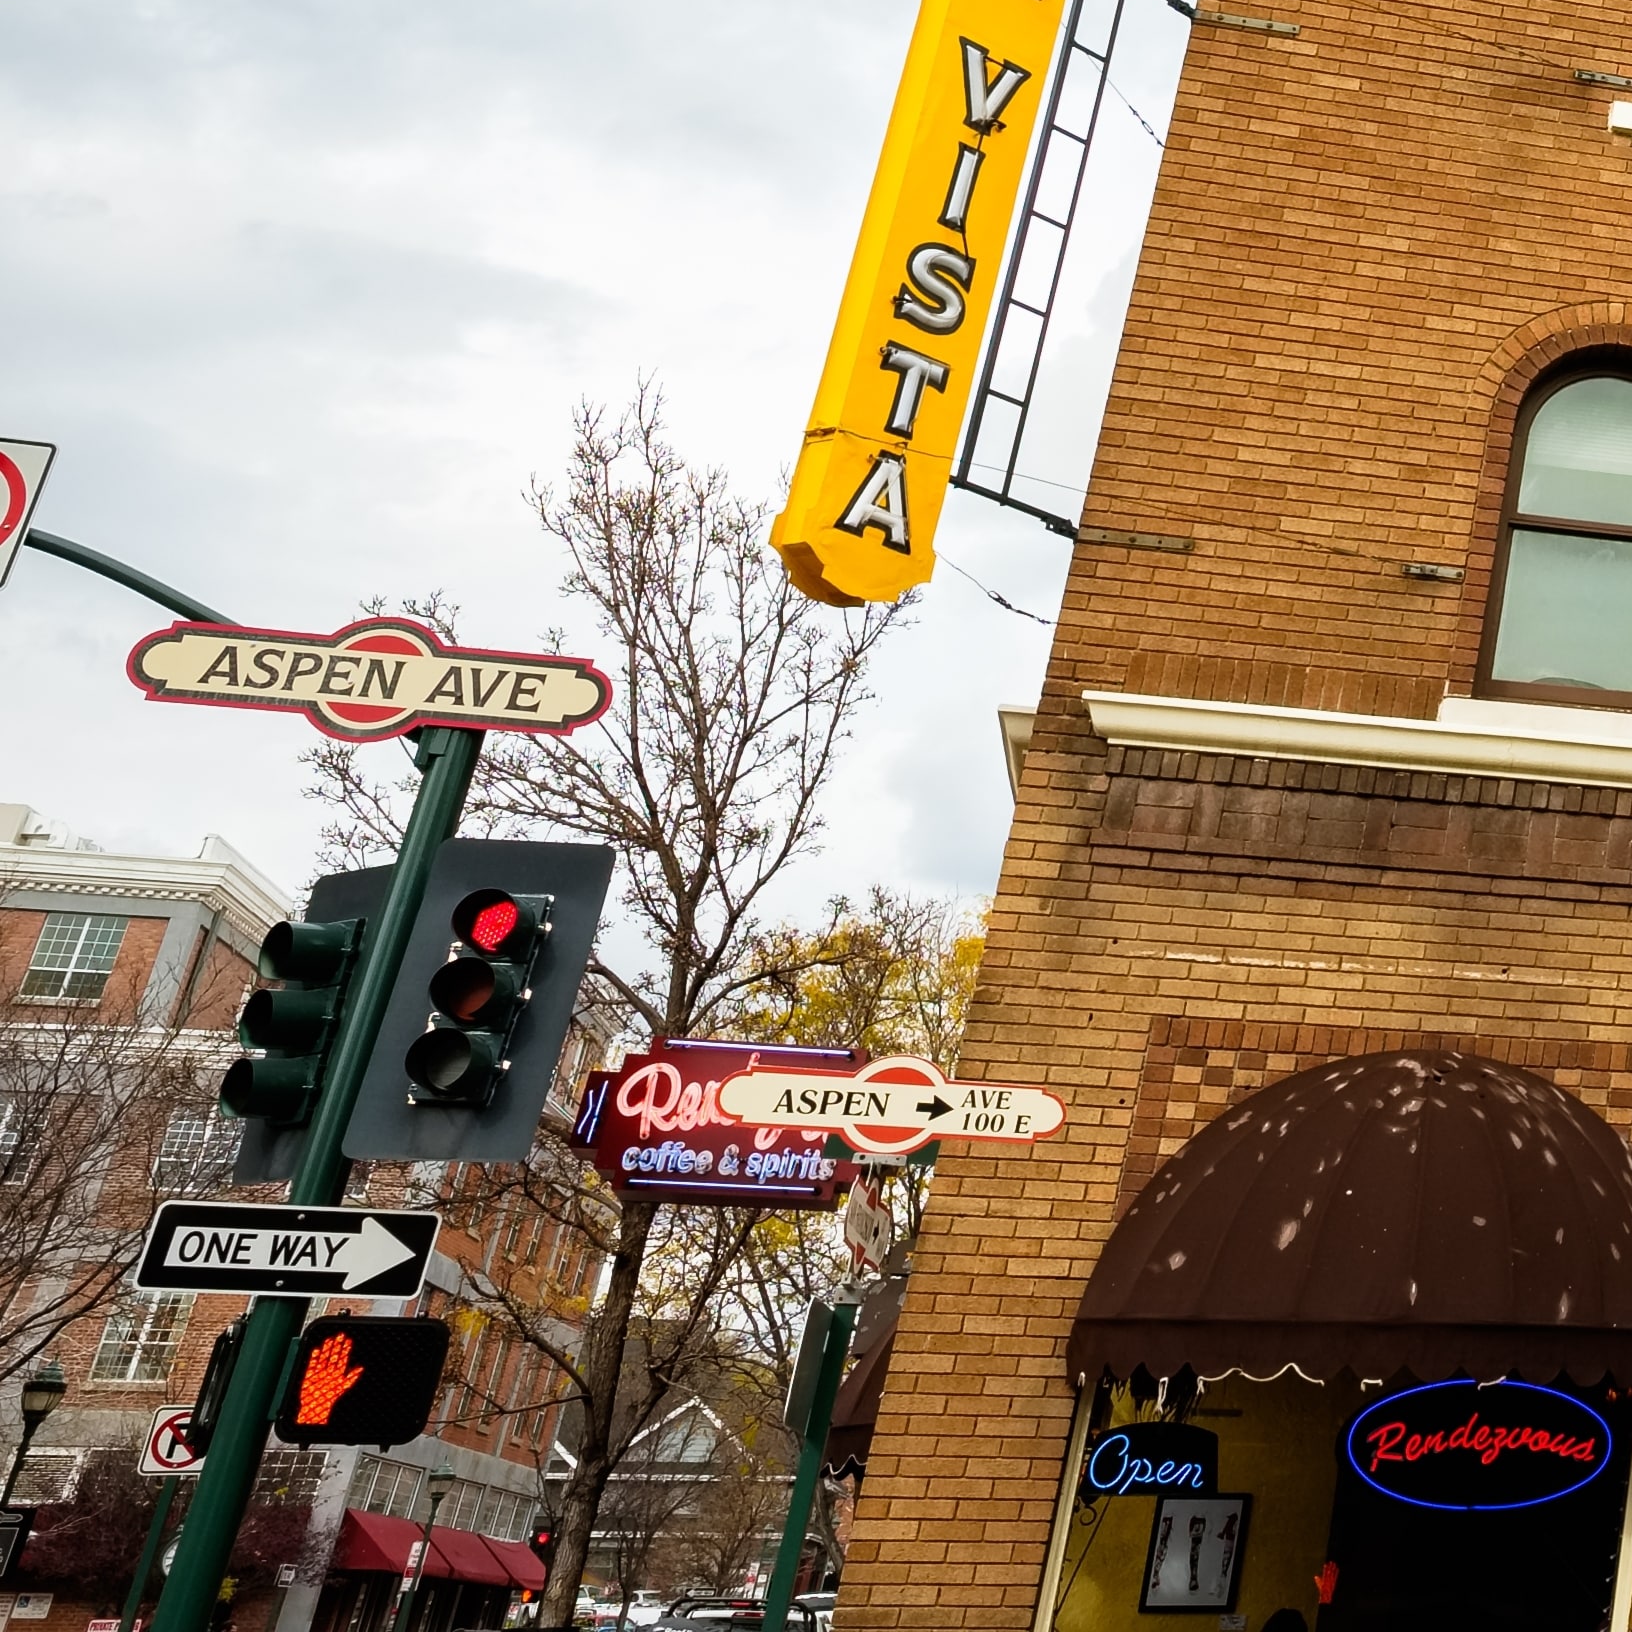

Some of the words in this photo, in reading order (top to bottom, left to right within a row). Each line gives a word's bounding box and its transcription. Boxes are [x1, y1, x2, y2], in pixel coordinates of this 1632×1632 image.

[832, 35, 1032, 556] VISTA
[197, 645, 407, 700] ASPEN
[423, 668, 547, 714] AVE
[773, 1088, 893, 1118] ASPEN
[959, 1089, 1013, 1110] AVE
[962, 1112, 1005, 1134] 100
[1014, 1114, 1032, 1134] E
[621, 1141, 713, 1174] coffee
[717, 1144, 740, 1176] &
[746, 1147, 837, 1185] spirits
[178, 1230, 259, 1265] ONE
[268, 1234, 350, 1268] WAY
[1090, 1434, 1204, 1494] Open
[1367, 1413, 1595, 1471] Rendezvous
